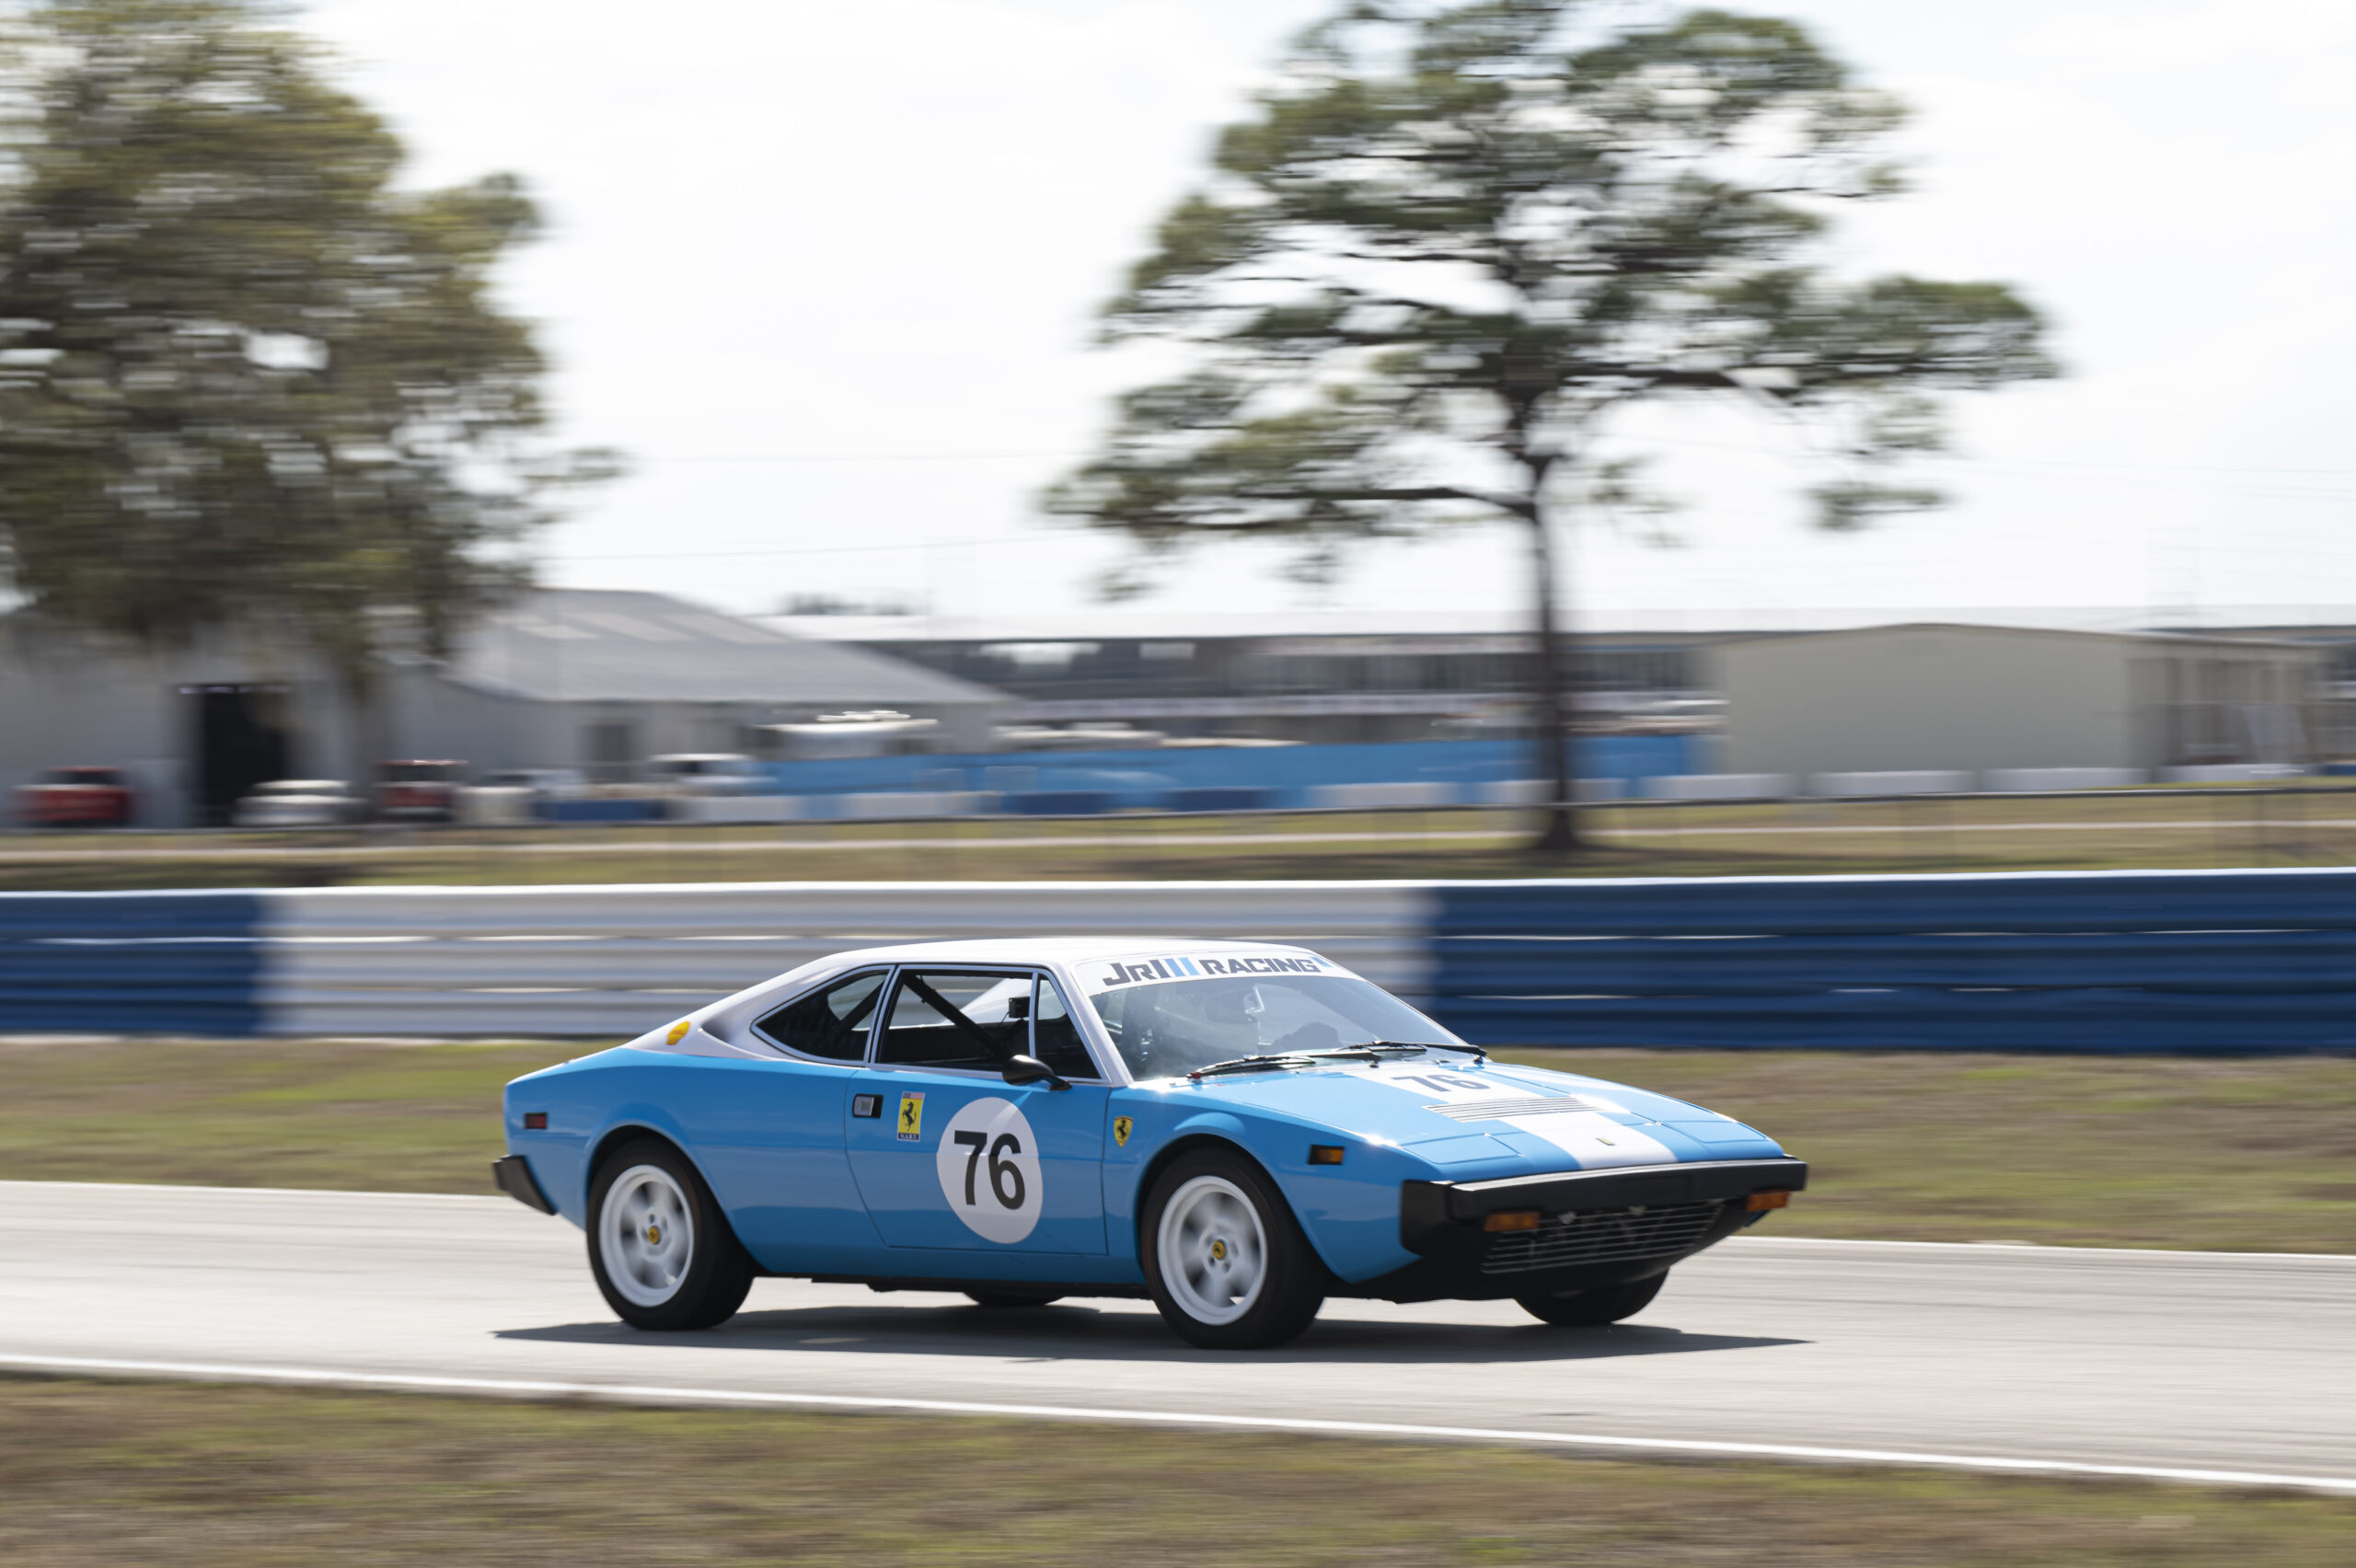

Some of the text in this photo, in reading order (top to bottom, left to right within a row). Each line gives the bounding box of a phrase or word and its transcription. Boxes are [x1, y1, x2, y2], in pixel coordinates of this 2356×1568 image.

[1198, 958, 1322, 974] RACING
[1391, 1075, 1490, 1091] 76
[954, 1130, 1025, 1210] 76
